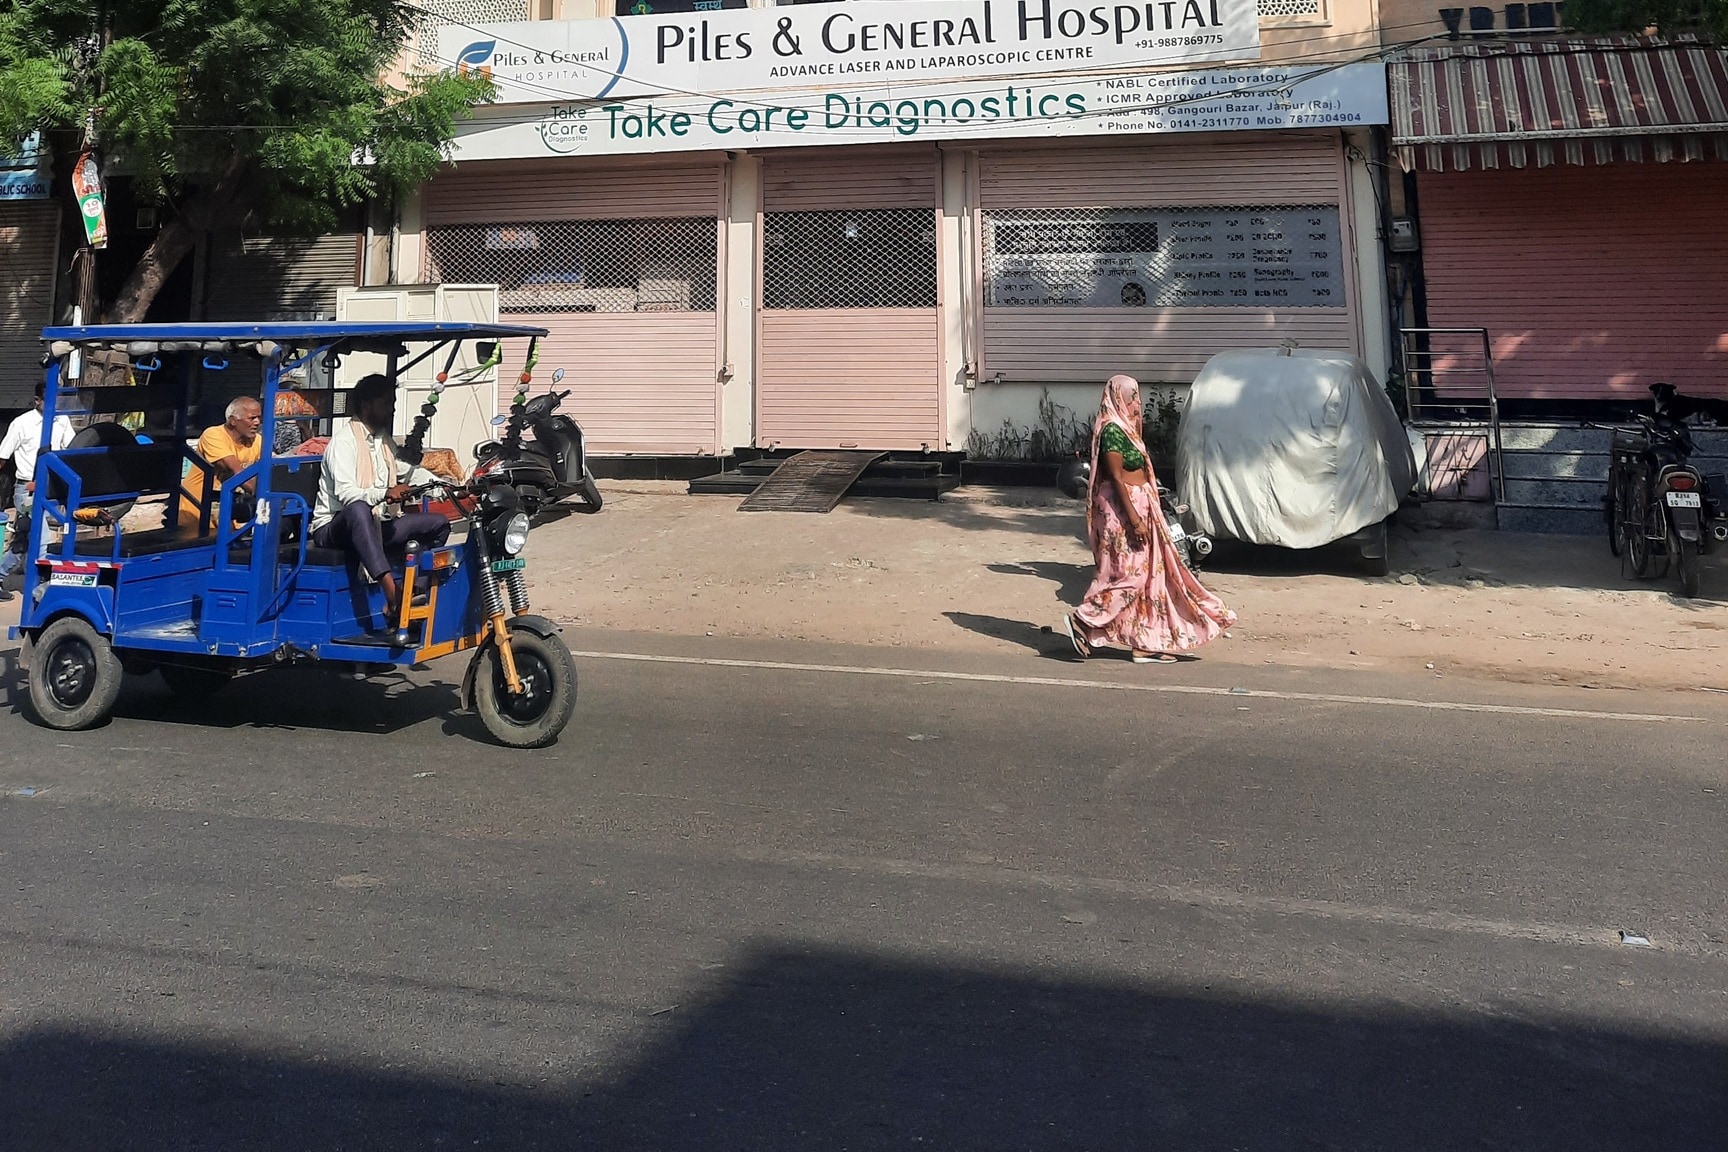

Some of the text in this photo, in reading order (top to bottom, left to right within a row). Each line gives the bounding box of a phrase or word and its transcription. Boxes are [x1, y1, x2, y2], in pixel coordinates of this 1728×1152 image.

[772, 16, 803, 57] &
[1135, 34, 1224, 49] +91-9887869775
[533, 51, 545, 65] &
[769, 47, 1094, 78] ADVANCE LASER AND LAPAROSCOPIC CENTRE
[515, 69, 588, 82] HOSPITAL
[1106, 73, 1288, 89] NABL Certified Laboratory
[1106, 93, 1142, 104] ICMR
[551, 106, 587, 120] Take
[602, 85, 1087, 140] Take Care Diagnostics
[1168, 104, 1221, 116] Gangouri
[1226, 103, 1263, 113] Bazar,
[1308, 99, 1341, 111] (Raj.)
[1108, 113, 1362, 130] Phone No. 0141-2311770 Mob. 7877304904
[548, 122, 588, 136] Care
[548, 135, 588, 144] Diagnostics
[16, 183, 47, 195] SCHOOL
